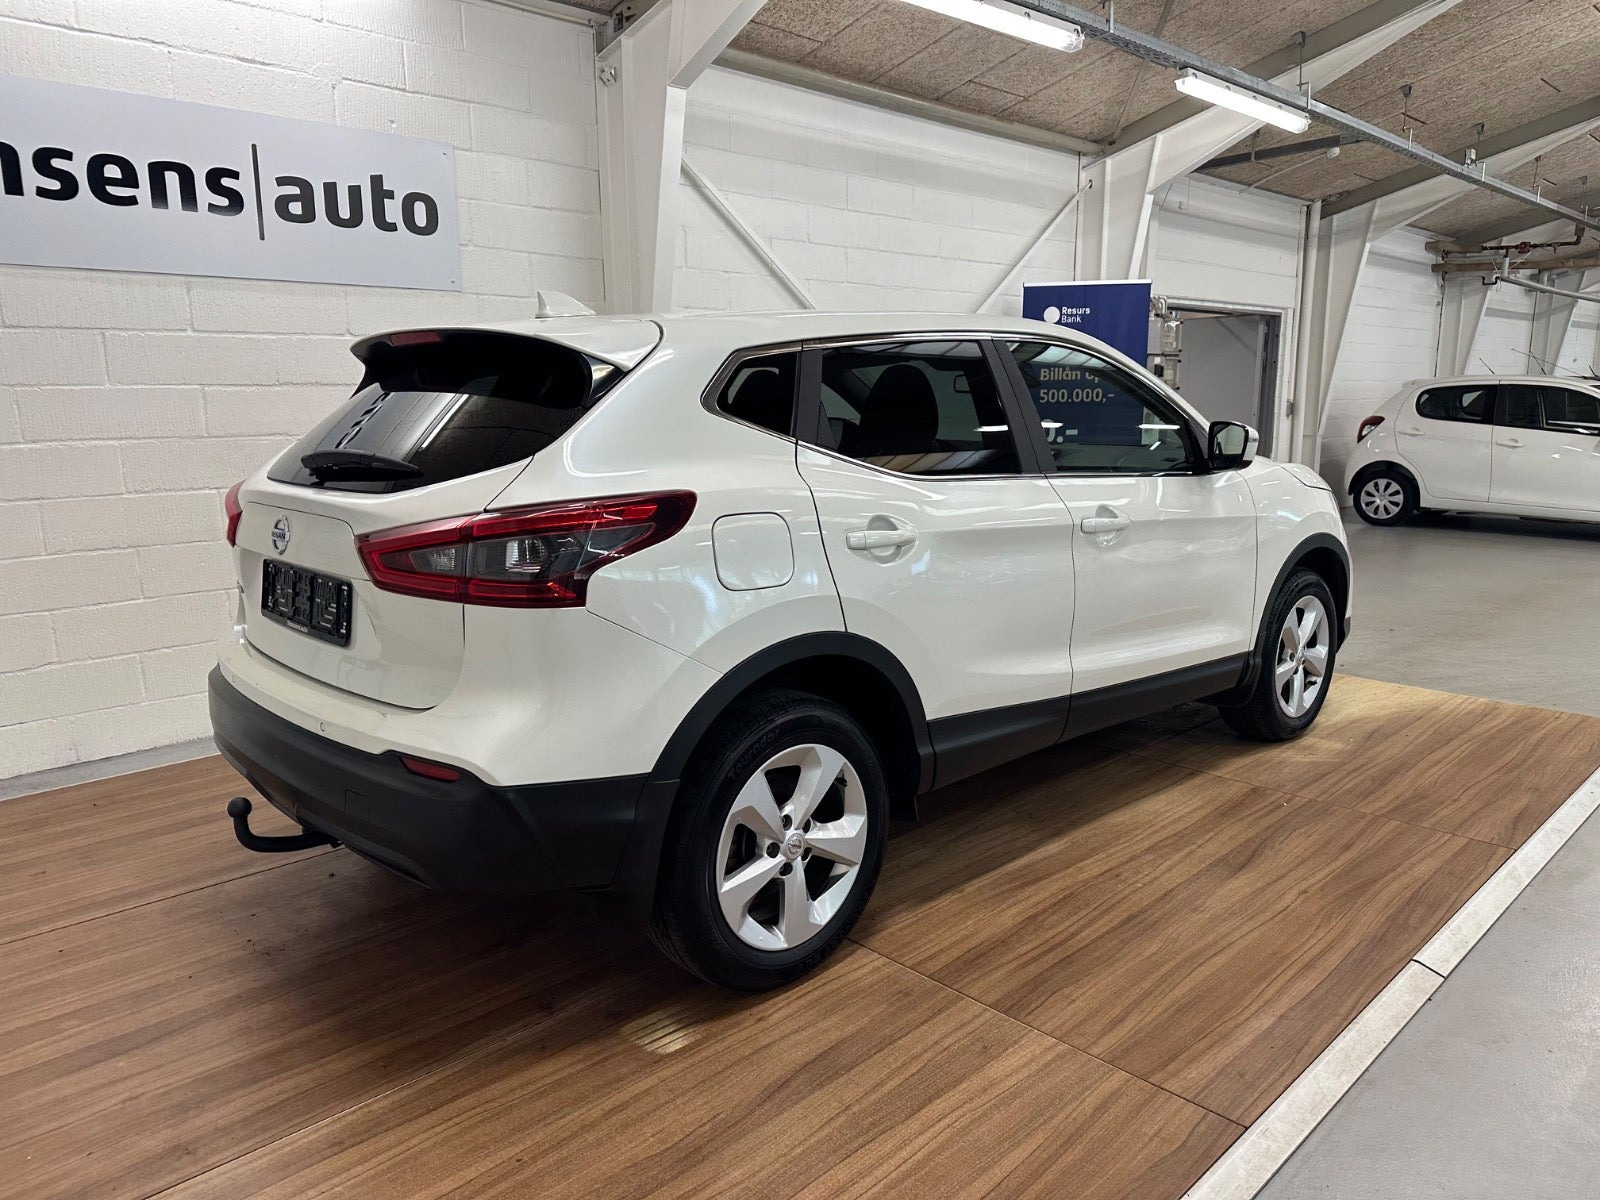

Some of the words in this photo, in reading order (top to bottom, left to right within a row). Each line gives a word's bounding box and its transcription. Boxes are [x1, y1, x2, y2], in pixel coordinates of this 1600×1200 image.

[1061, 306, 1091, 315] Resurs
[1061, 315, 1082, 323] Bank
[1040, 367, 1081, 381] Billån
[1039, 388, 1115, 404] 500.000,-
